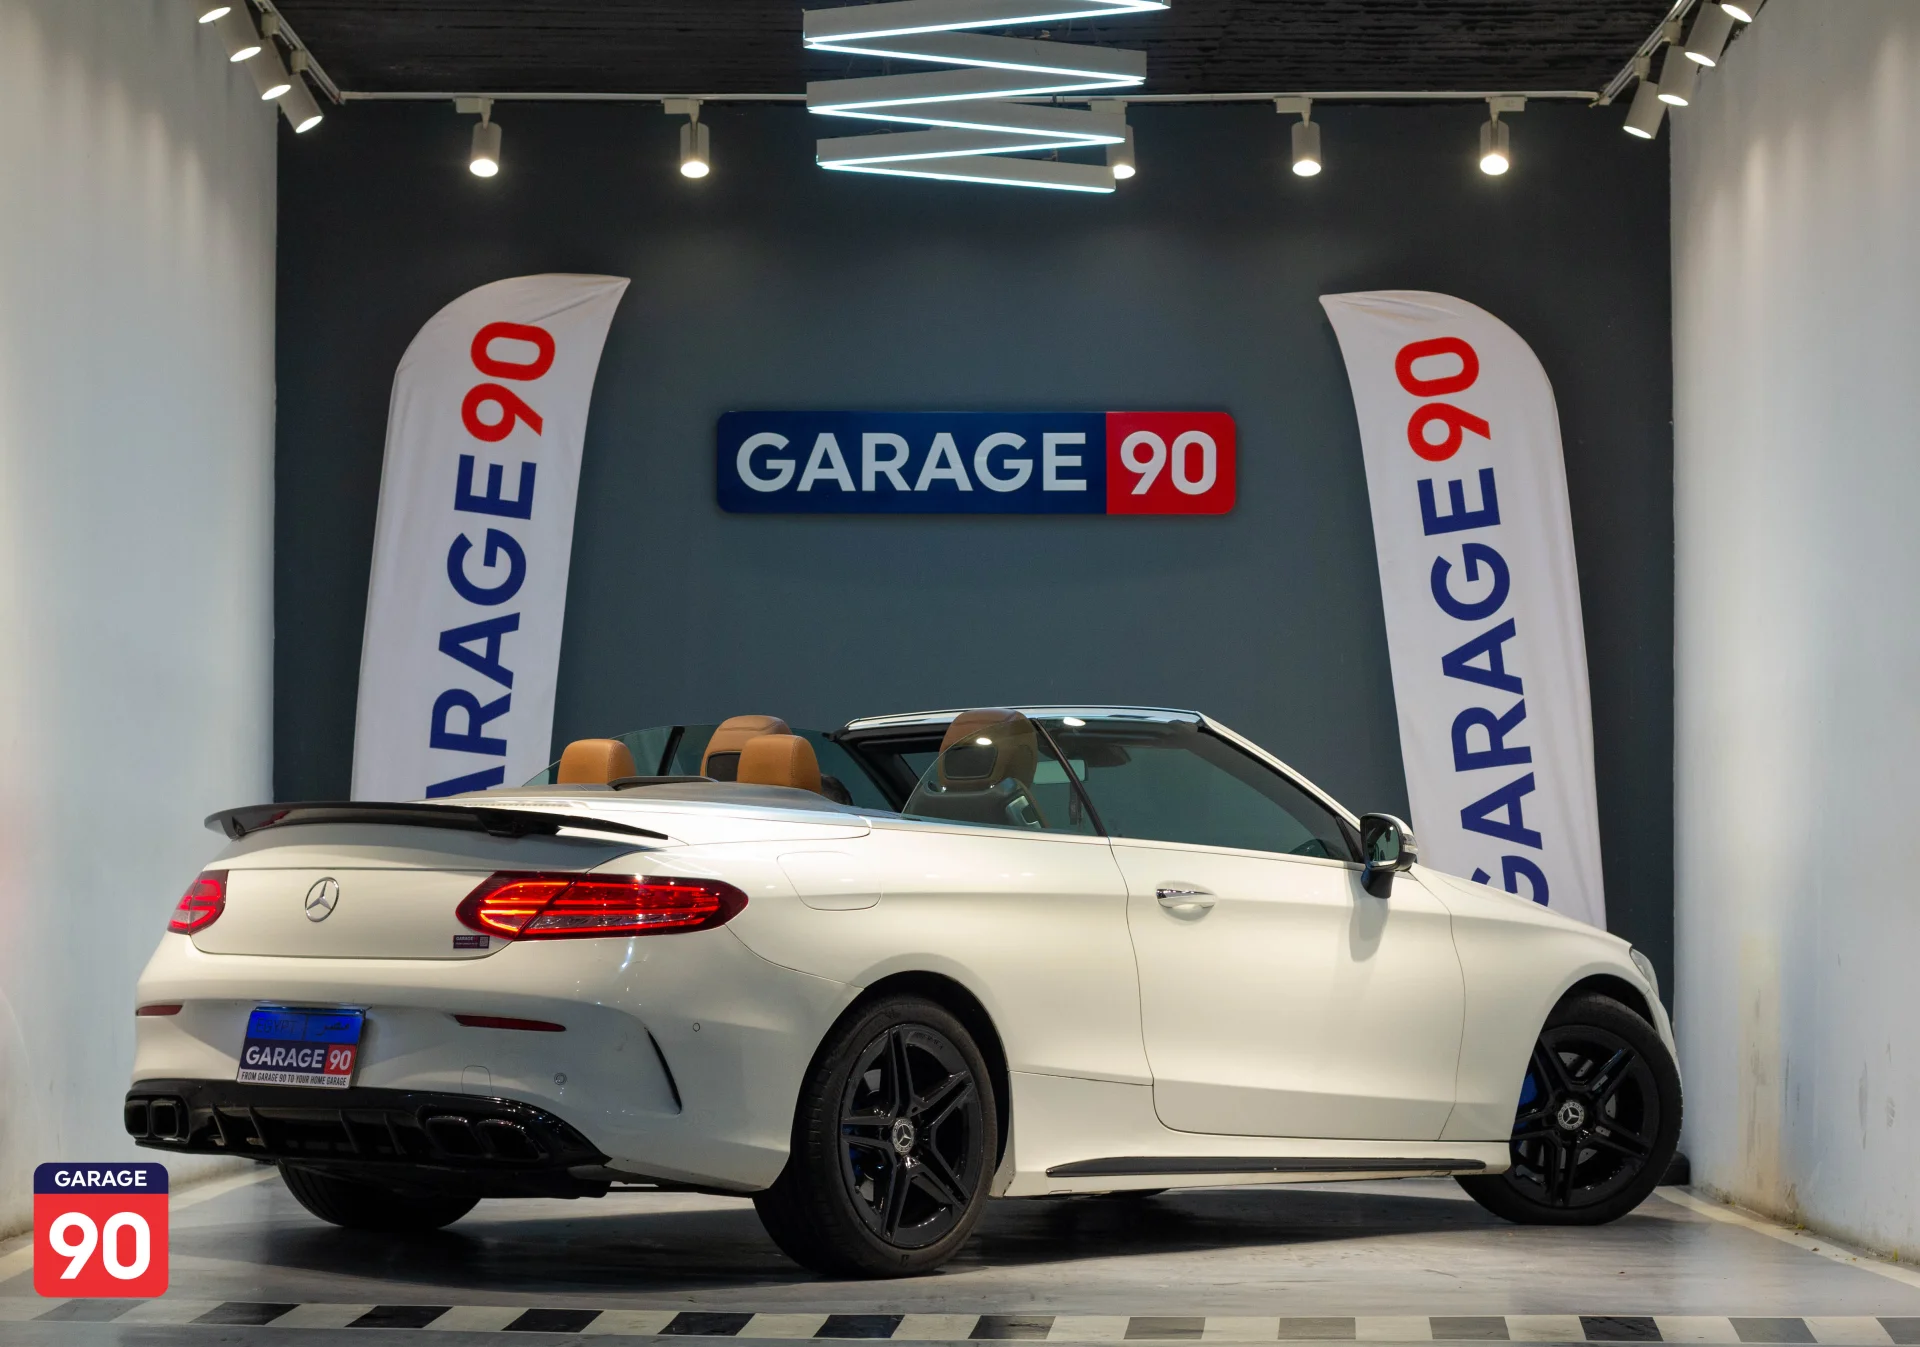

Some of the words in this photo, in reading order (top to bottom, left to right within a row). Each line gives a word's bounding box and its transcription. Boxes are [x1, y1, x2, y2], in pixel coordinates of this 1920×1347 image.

[736, 431, 1087, 493] GARAGE
[1120, 430, 1217, 495] 90
[256, 1018, 298, 1035] EGYPT
[245, 1046, 325, 1068] GARAGE
[329, 1050, 352, 1071] 90
[241, 1071, 257, 1081] FROM
[258, 1072, 279, 1082] GARAGE
[280, 1073, 287, 1083] 90
[288, 1074, 295, 1083] TO
[295, 1074, 310, 1084] YOUR
[310, 1075, 326, 1085] HOME
[326, 1076, 347, 1086] GARAGE
